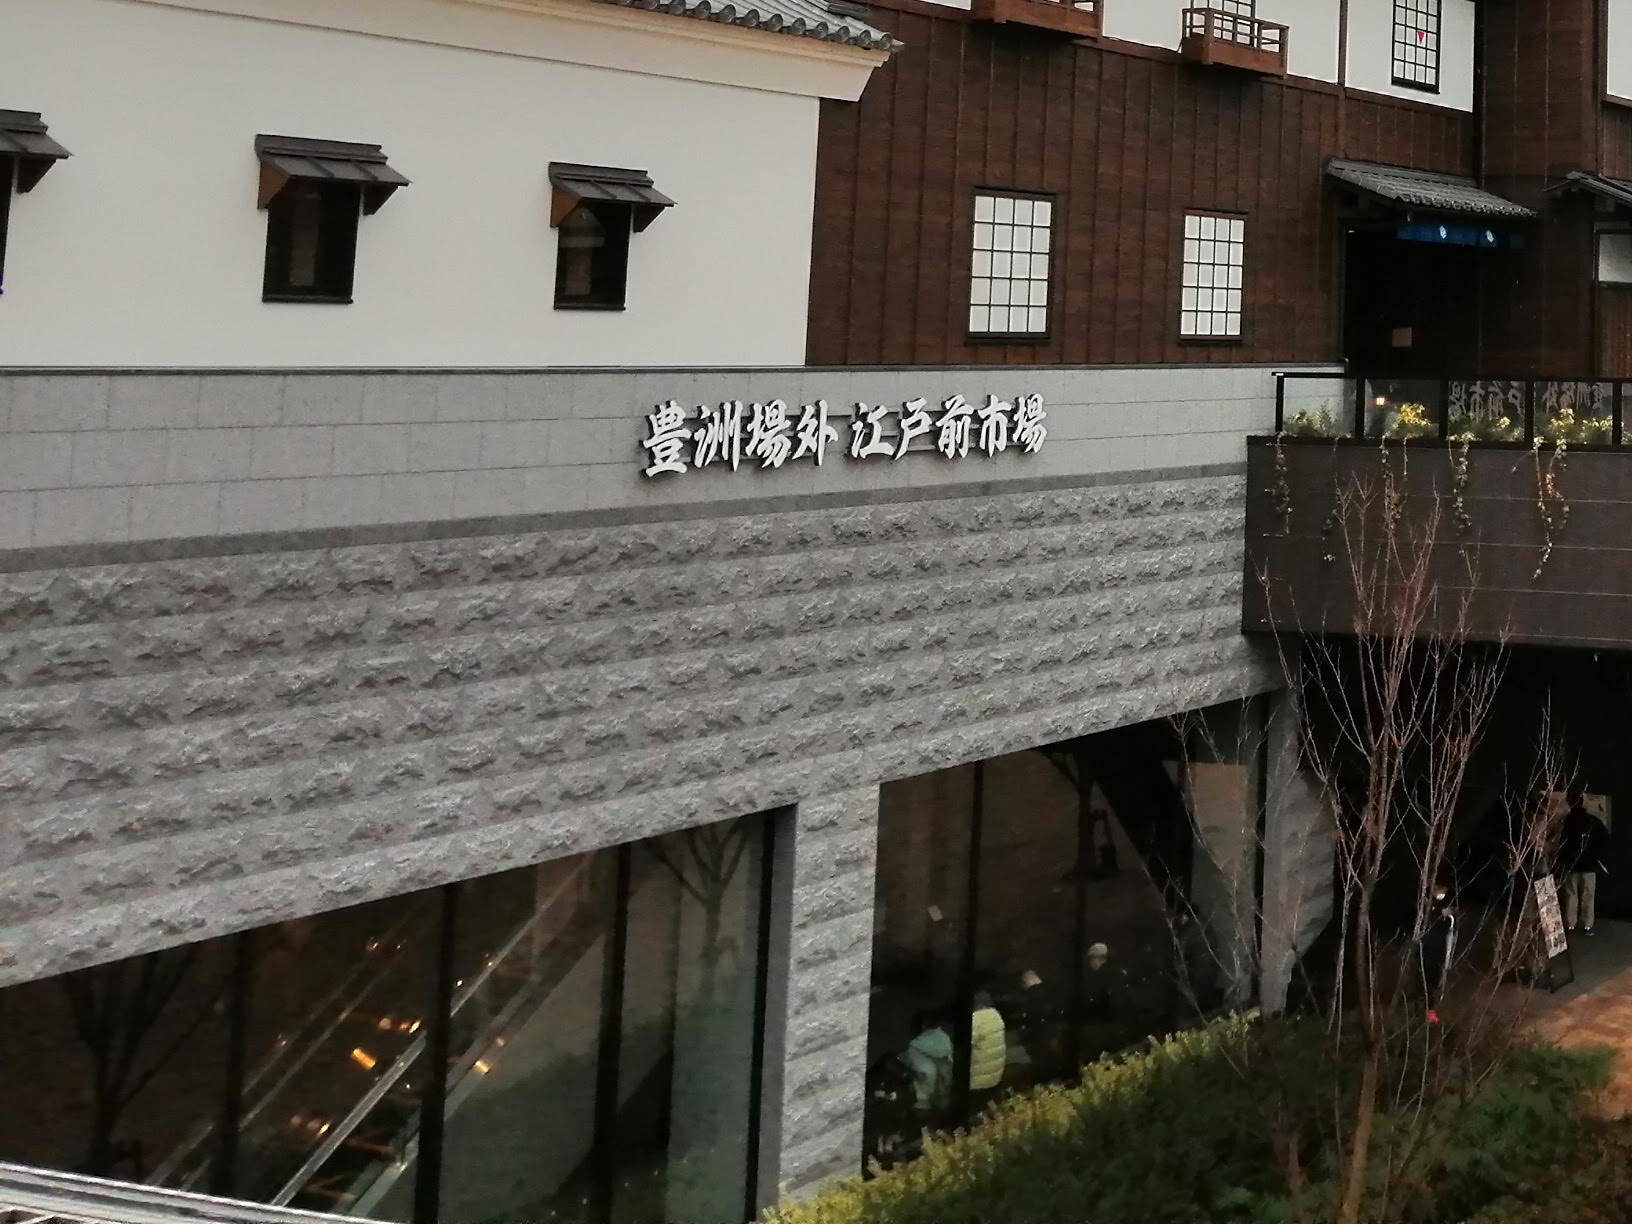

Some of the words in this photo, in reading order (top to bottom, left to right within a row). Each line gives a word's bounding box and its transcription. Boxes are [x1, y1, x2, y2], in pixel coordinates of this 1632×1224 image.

[642, 399, 839, 478] 豊洲場外
[850, 393, 1048, 461] 江戸前市場
